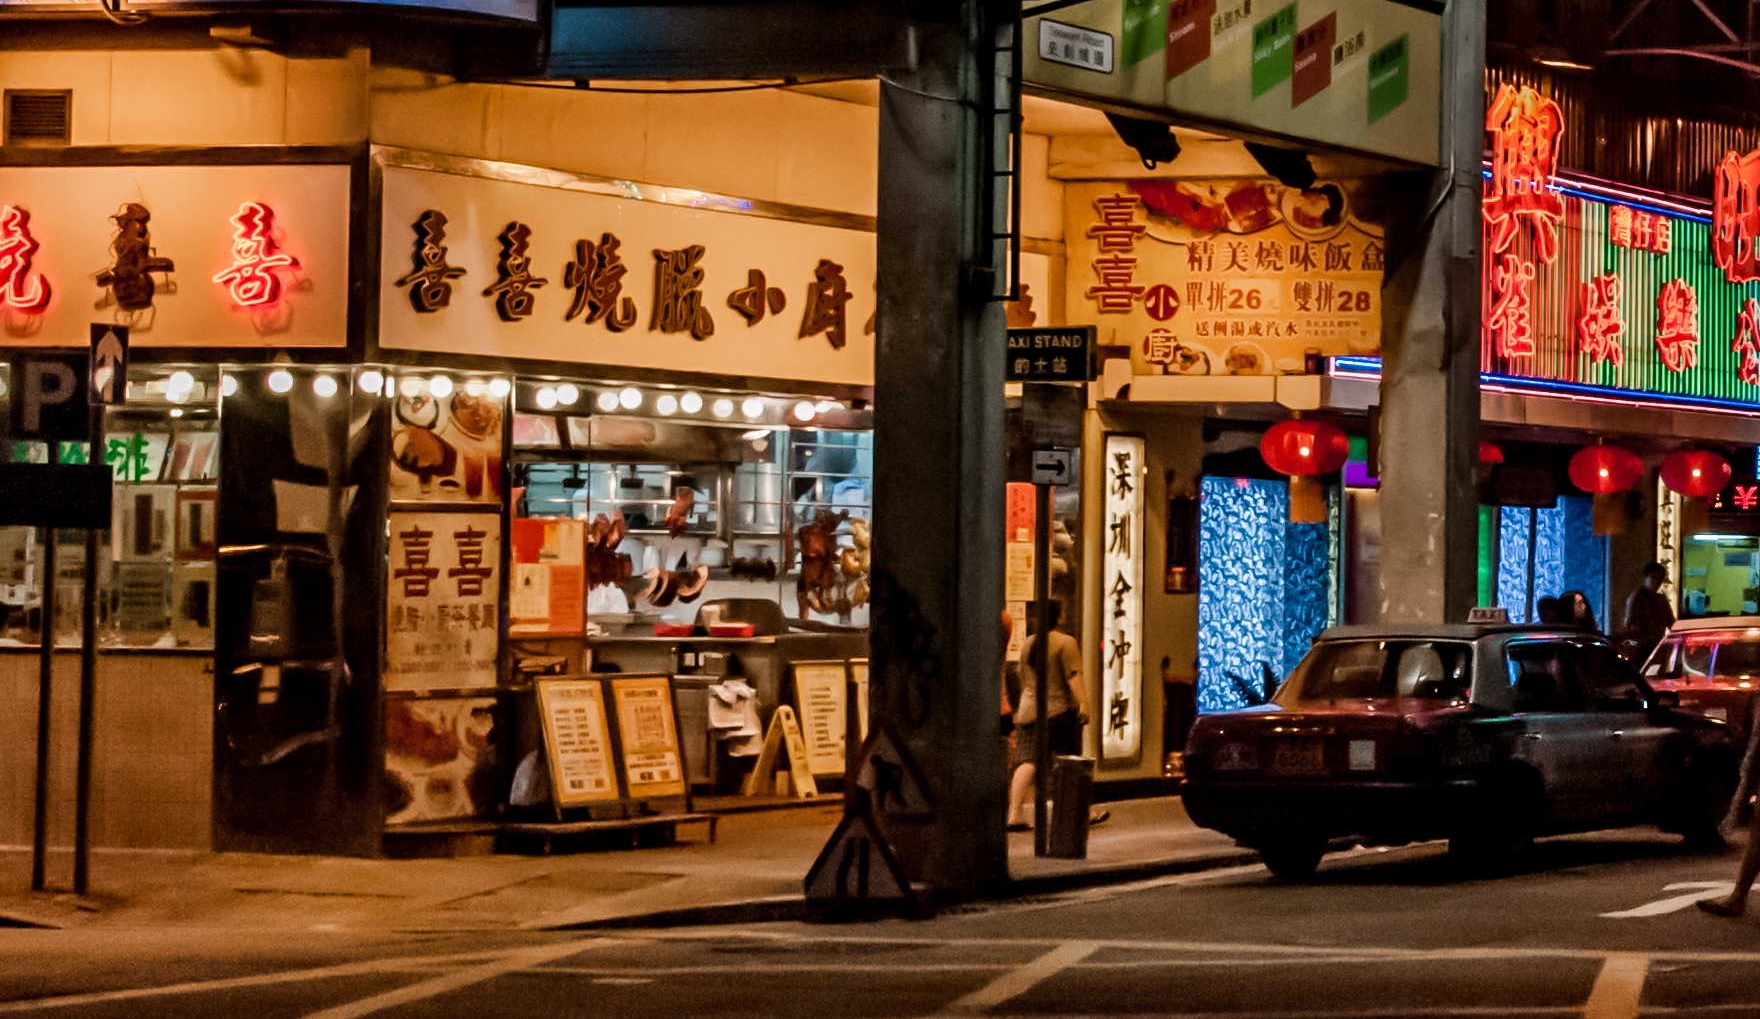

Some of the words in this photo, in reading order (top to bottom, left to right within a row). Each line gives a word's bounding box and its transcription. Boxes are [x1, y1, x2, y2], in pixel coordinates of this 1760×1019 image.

[1088, 193, 1146, 313] 喜喜
[1610, 204, 1673, 257] 灣仔店
[397, 208, 877, 350] 喜喜燒臘小廚
[1007, 335, 1031, 349] AXI
[1033, 334, 1083, 349] STAND
[1014, 357, 1068, 375] 的士站
[24, 361, 77, 432] P
[394, 525, 493, 598] 喜喜
